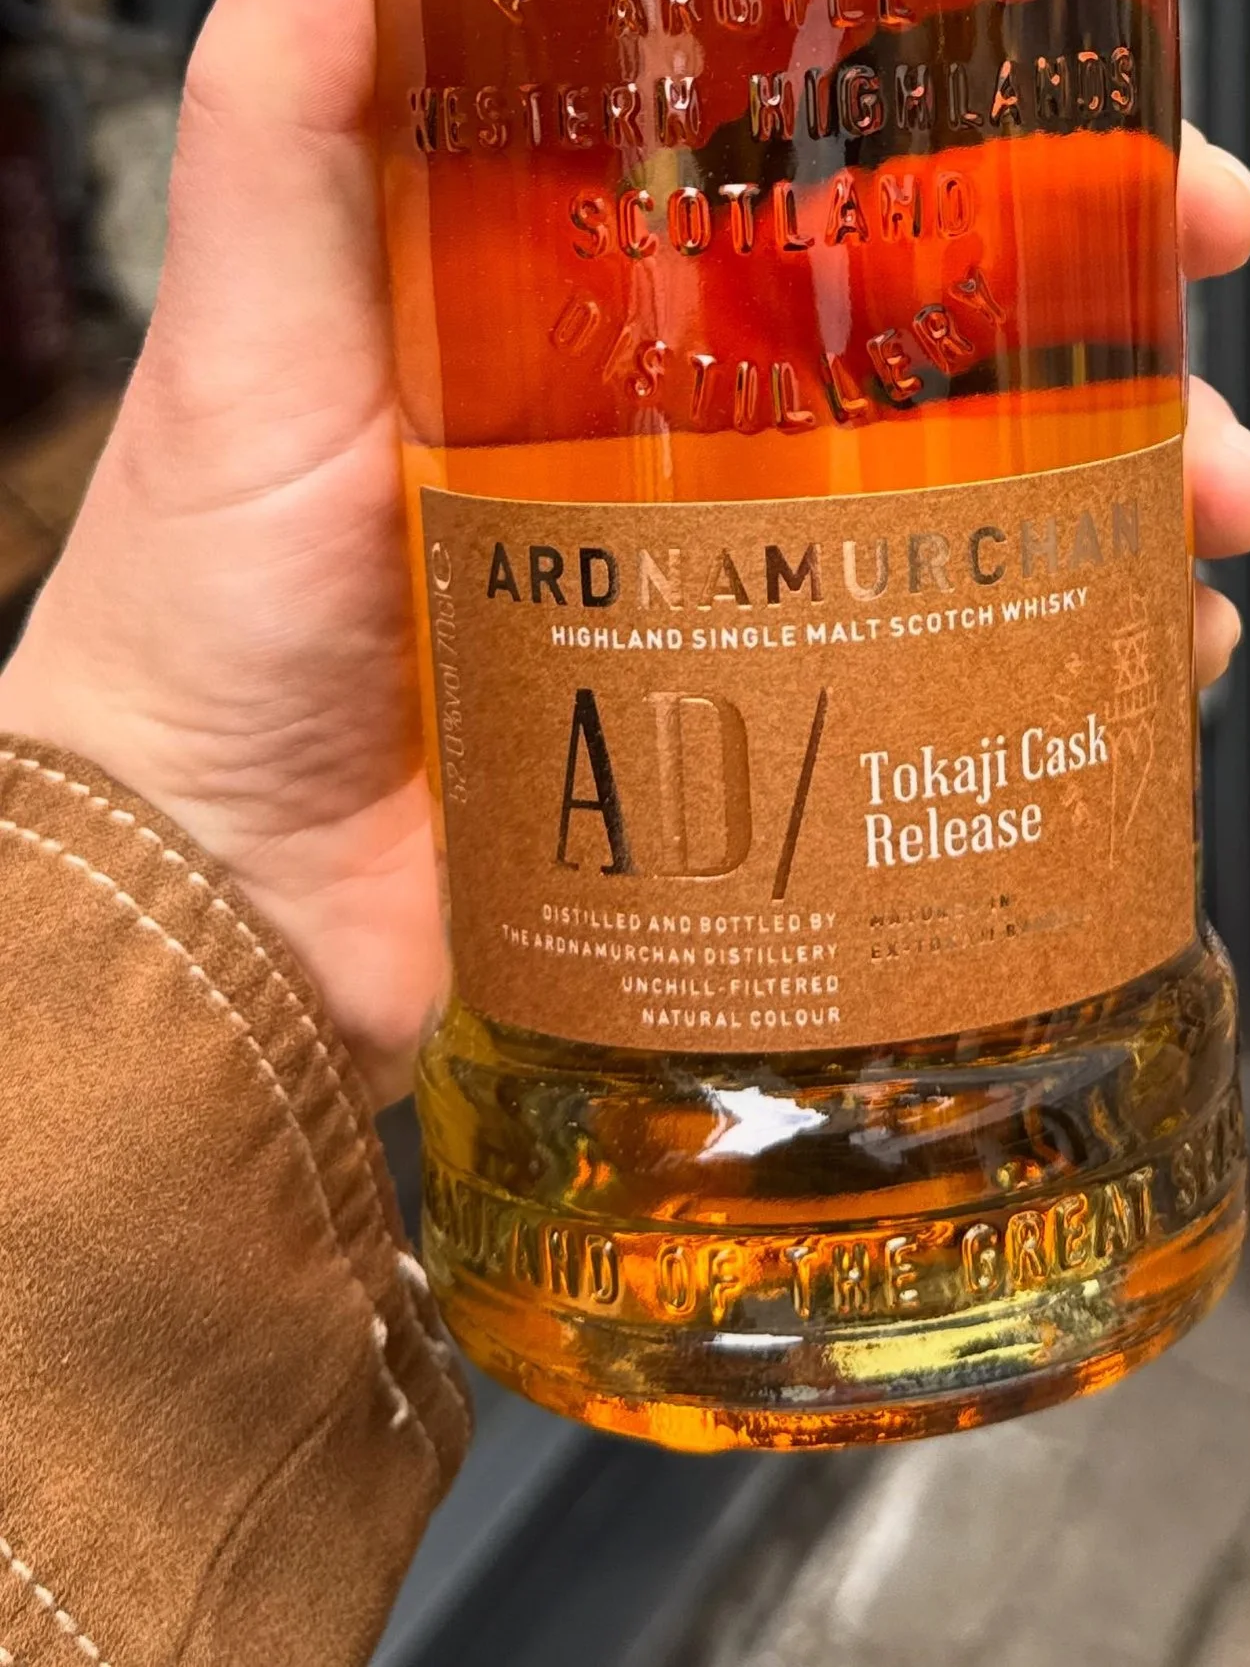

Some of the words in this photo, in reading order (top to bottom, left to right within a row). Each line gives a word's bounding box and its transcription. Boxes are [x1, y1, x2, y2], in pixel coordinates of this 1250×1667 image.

[408, 72, 702, 158] WESTERN
[747, 46, 1137, 145] HIGHLANDS
[568, 168, 976, 260] SCOTLAND
[548, 264, 1008, 435] DISTILLERY
[486, 499, 1139, 610] ARDNAMURCHAN
[551, 625, 682, 650] HIGHLAND
[692, 625, 796, 649] SINGLE
[806, 618, 881, 645] MALT
[890, 605, 994, 638] SCOTCH
[1001, 587, 1088, 623] WHISKY
[860, 735, 1008, 805] Tokaji
[1021, 713, 1108, 781] Cask
[864, 803, 1042, 868] Release
[502, 924, 529, 946] THE
[534, 933, 696, 965] ARDNAMURCHAN
[704, 943, 838, 965] DISTILLERY
[542, 903, 641, 932] DISTILLED
[649, 914, 691, 933] AND
[700, 913, 800, 934] BOTTLED
[809, 912, 836, 930] BY
[621, 975, 839, 996] UNCHILL-FILTERED
[642, 1007, 742, 1028] NATURAL
[749, 1006, 840, 1028] COLOUR
[655, 1240, 746, 1327] OF
[780, 1236, 919, 1321] THE
[962, 1165, 1153, 1294] GREAT
